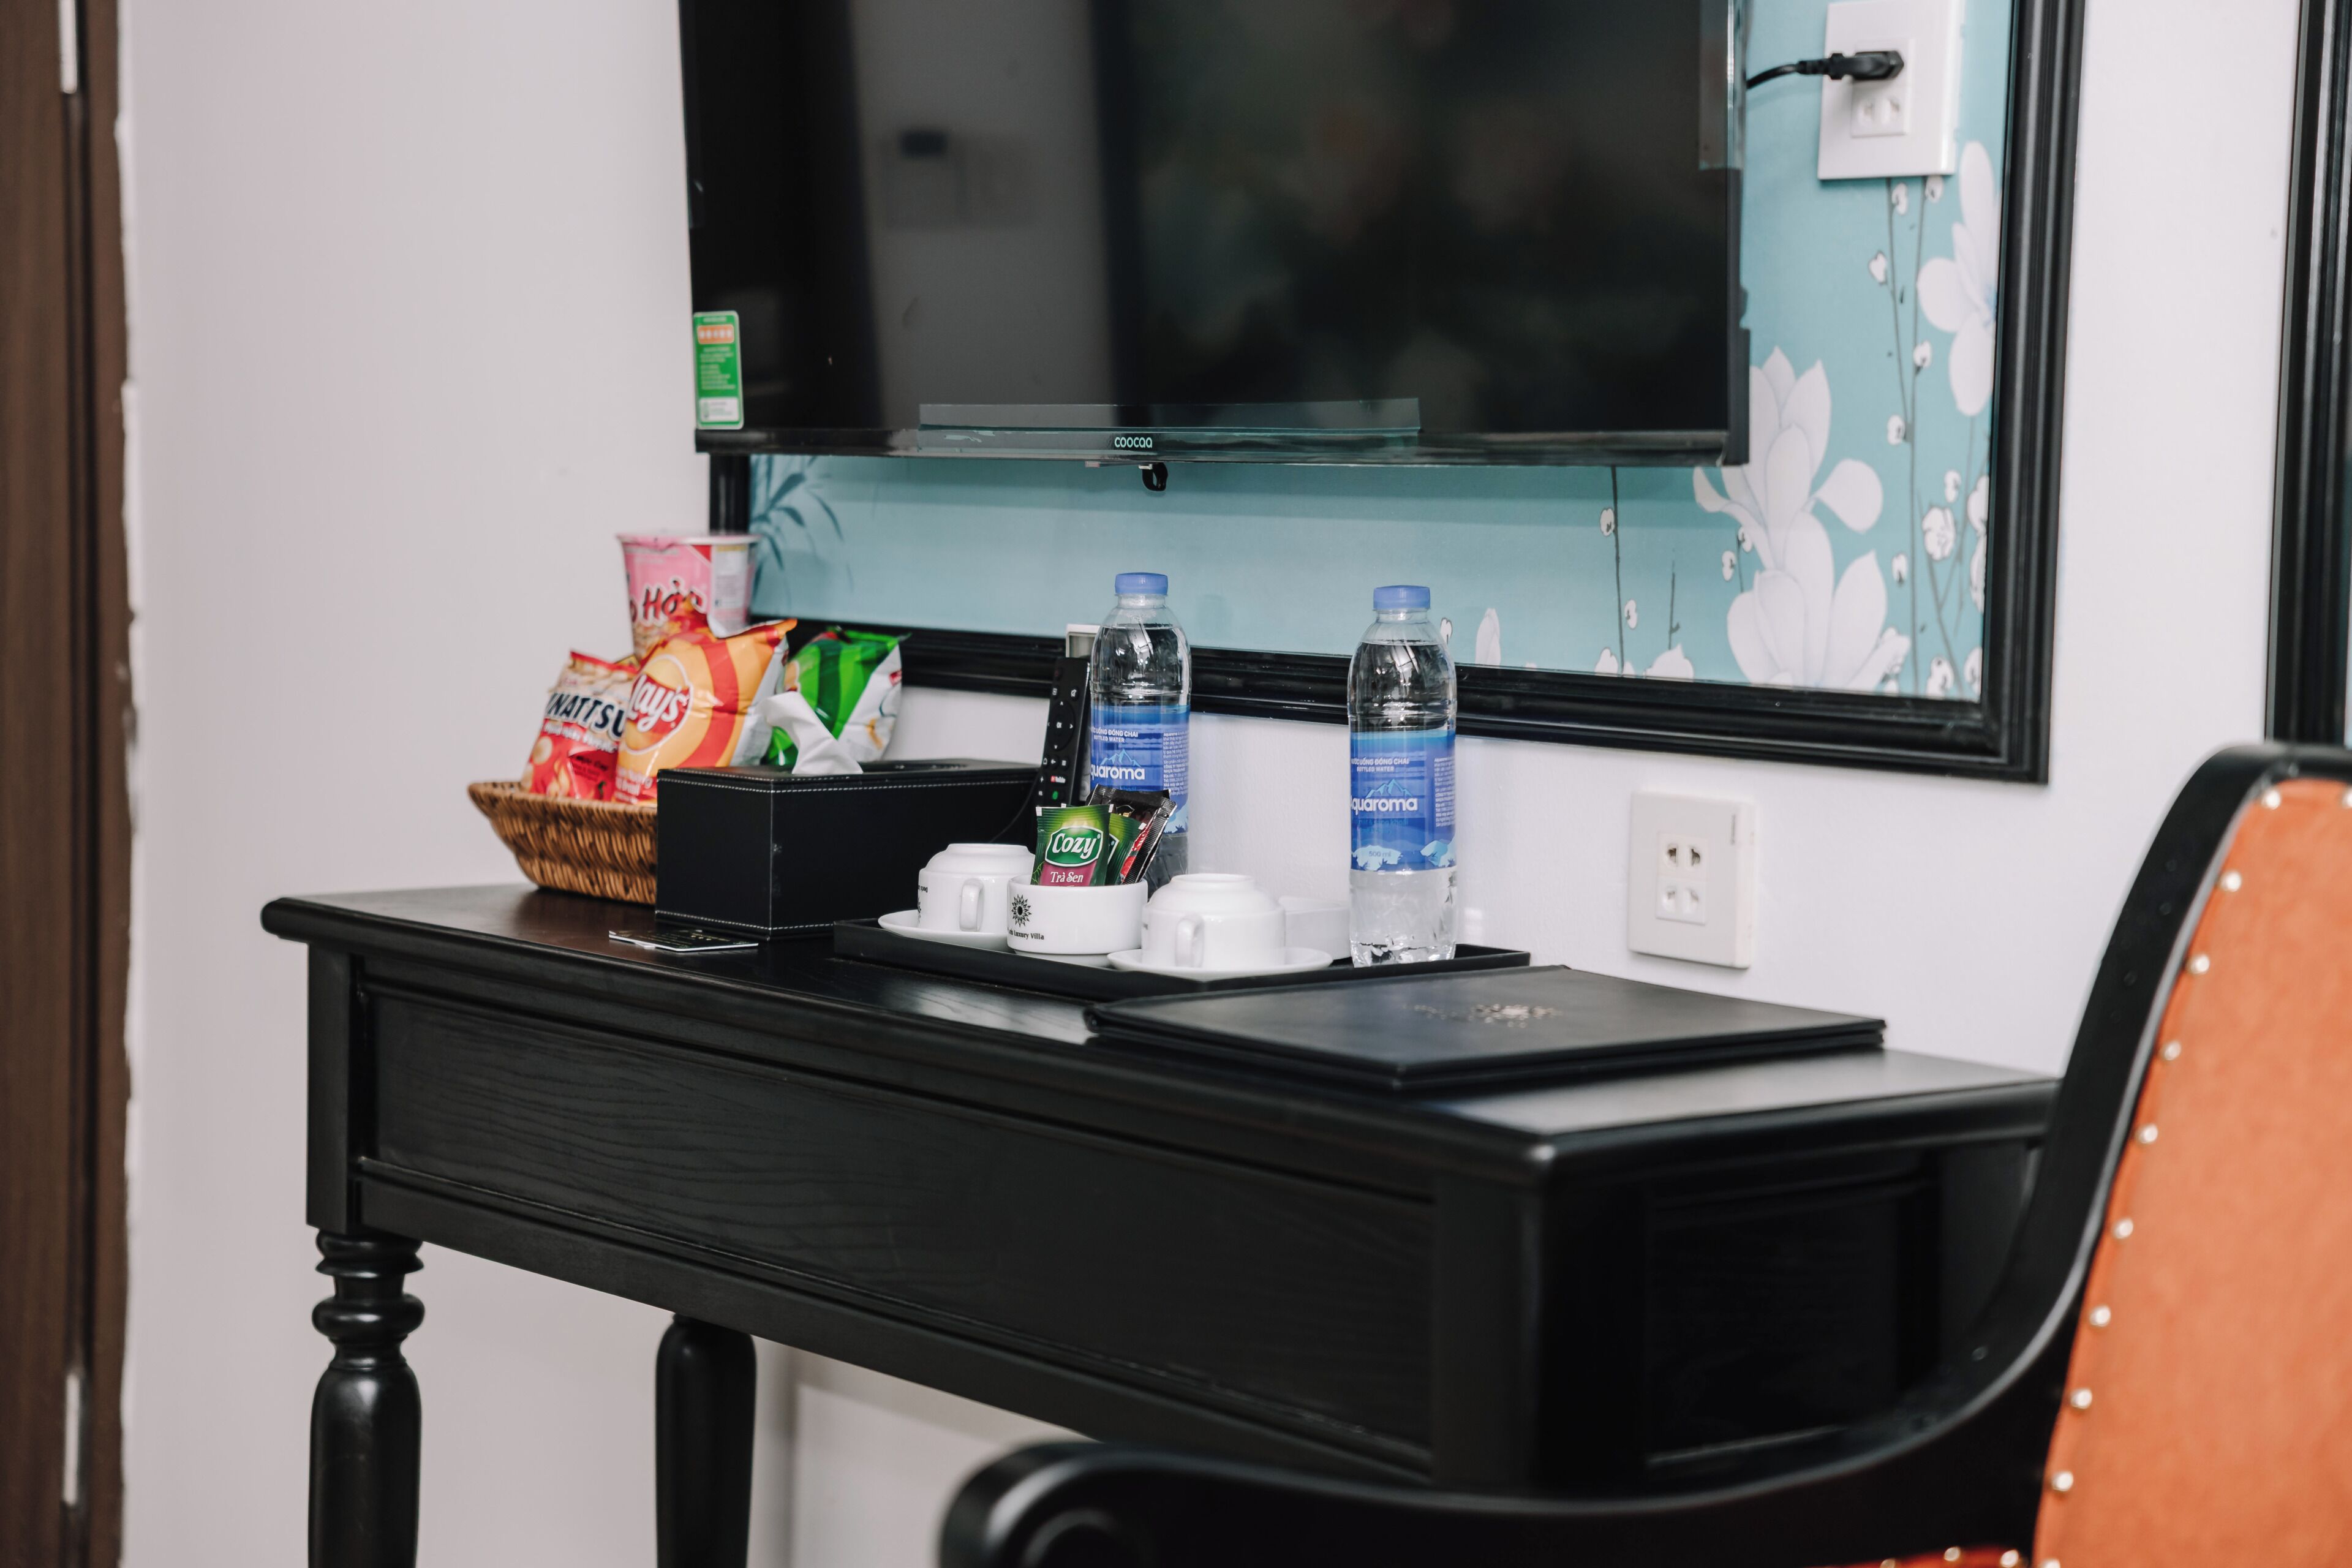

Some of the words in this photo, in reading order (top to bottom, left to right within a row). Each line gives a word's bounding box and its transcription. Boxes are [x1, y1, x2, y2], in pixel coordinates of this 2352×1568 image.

[1114, 437, 1153, 448] coocaa
[627, 674, 688, 733] Lay's
[1350, 796, 1418, 815] quaroma
[1052, 832, 1097, 859] Cozy
[1050, 870, 1066, 883] Trà
[1068, 872, 1084, 883] Sen
[1014, 930, 1029, 940] Luxury
